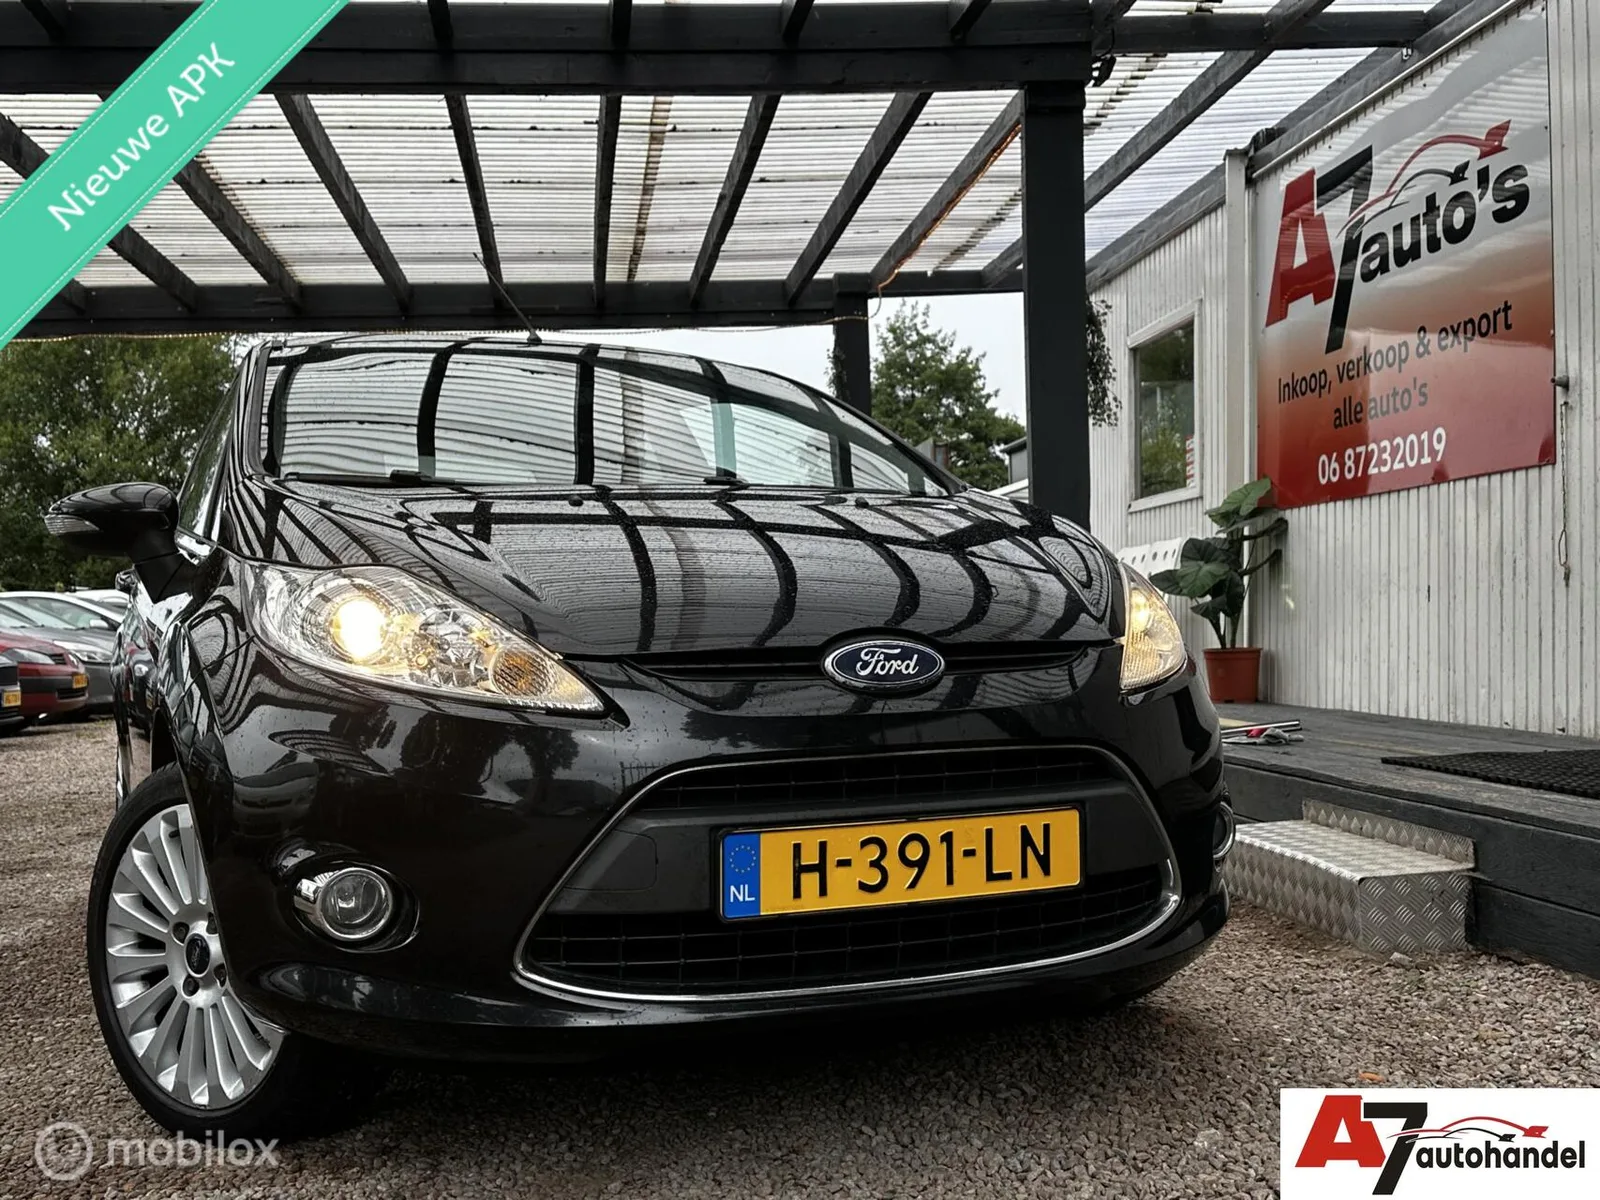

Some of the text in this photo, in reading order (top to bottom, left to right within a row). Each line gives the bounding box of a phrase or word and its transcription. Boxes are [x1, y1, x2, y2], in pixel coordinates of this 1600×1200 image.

[1360, 163, 1531, 284] auto's
[1278, 299, 1513, 404] Inkoop, verkoop & export
[1333, 376, 1429, 430] alle auto's
[1318, 425, 1447, 485] 06 87232019
[855, 647, 920, 676] Ford
[791, 822, 1051, 900] H-391-LN
[729, 883, 756, 903] NL
